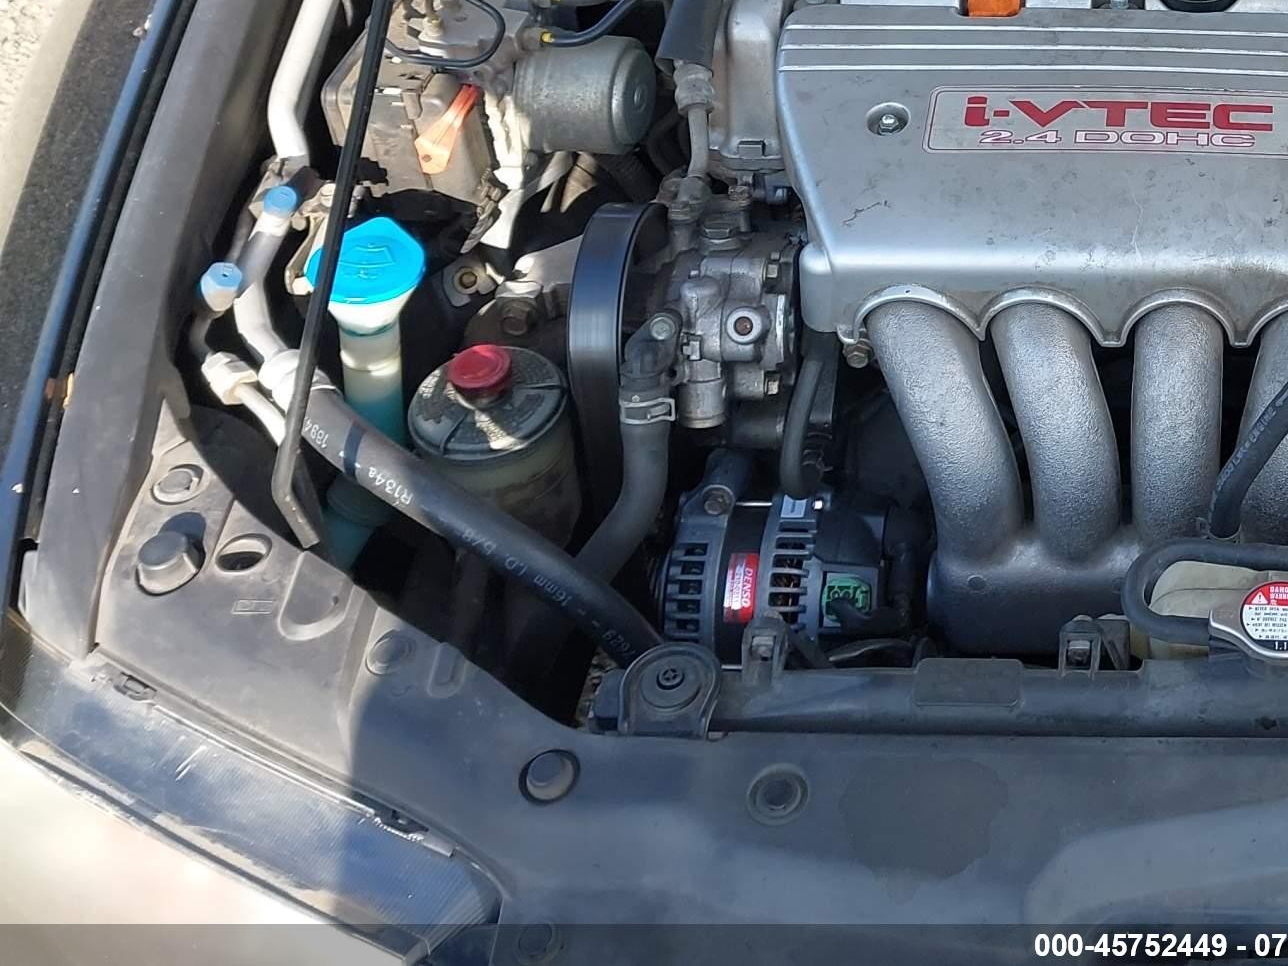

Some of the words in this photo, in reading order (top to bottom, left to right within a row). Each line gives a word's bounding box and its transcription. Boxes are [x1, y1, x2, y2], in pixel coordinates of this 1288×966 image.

[963, 96, 1274, 132] i-VTEC
[979, 128, 1062, 145] 2.4
[1074, 129, 1256, 148] DOHC
[367, 465, 414, 506] R134a
[533, 574, 573, 606] 16mm
[741, 568, 754, 608] DENSO
[1274, 641, 1288, 651] 1.1
